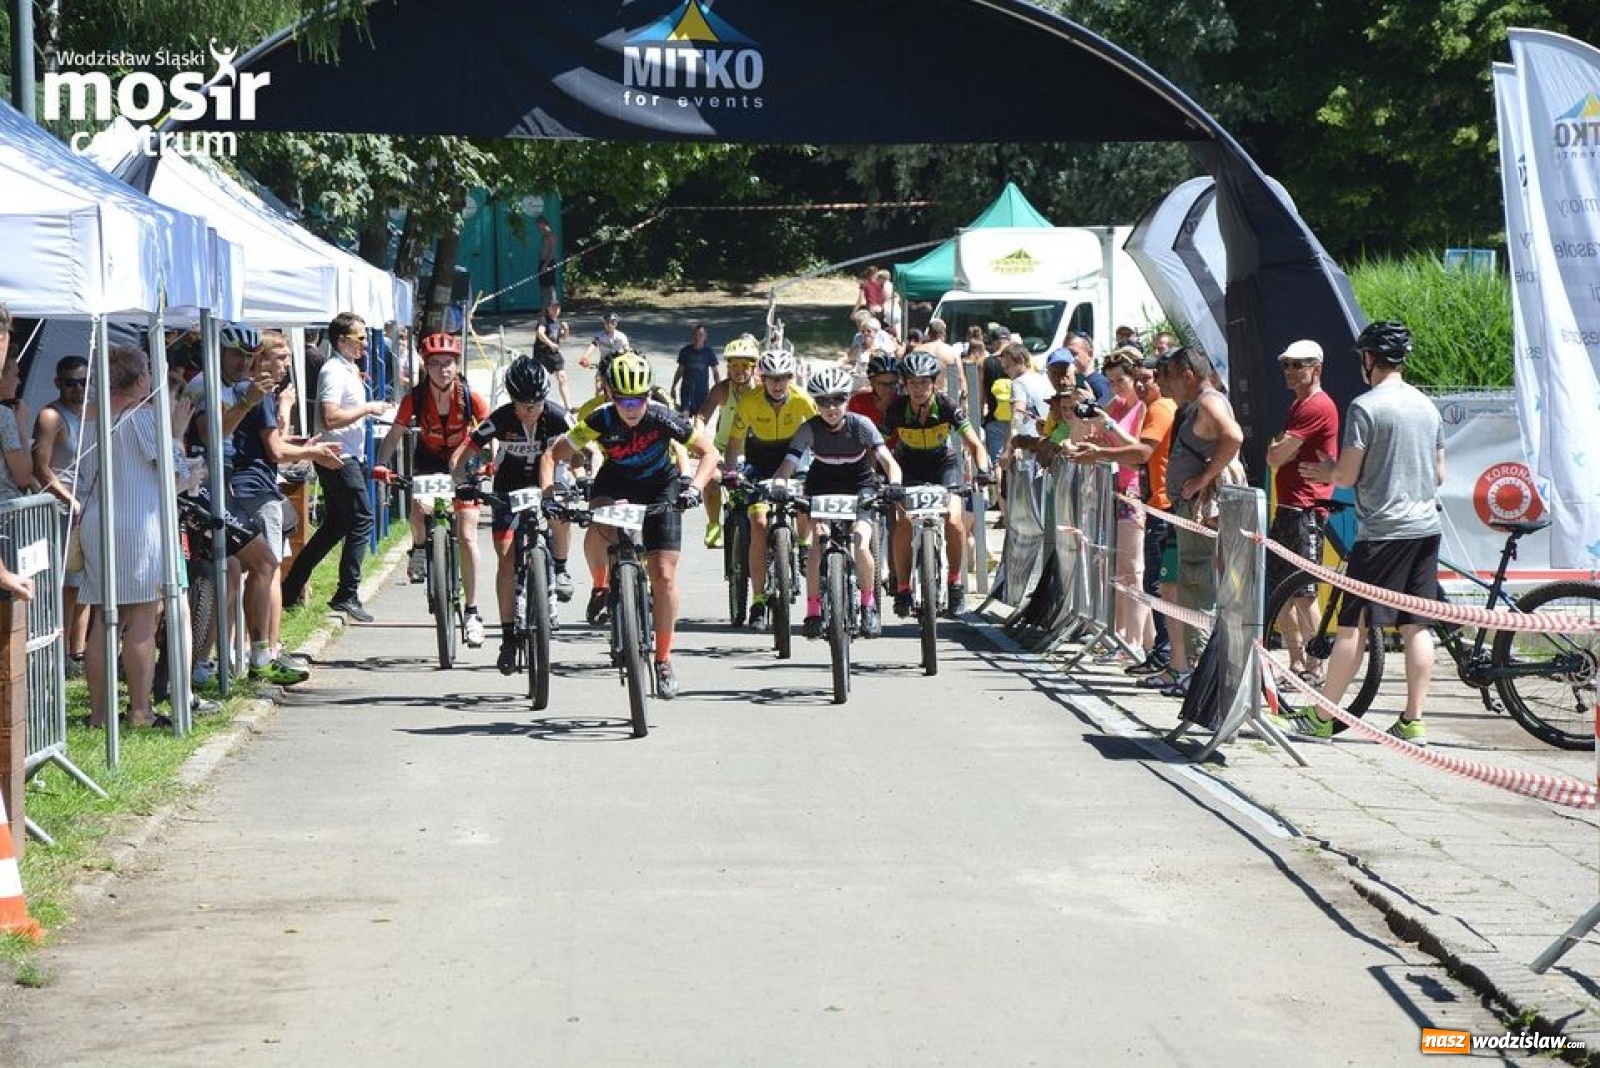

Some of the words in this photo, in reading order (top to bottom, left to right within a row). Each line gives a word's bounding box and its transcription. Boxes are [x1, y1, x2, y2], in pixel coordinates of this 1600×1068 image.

[623, 46, 764, 90] MITKO
[623, 91, 660, 106] for
[678, 96, 764, 109] events
[417, 479, 451, 493] 155
[818, 497, 854, 513] 152
[910, 493, 944, 508] 192
